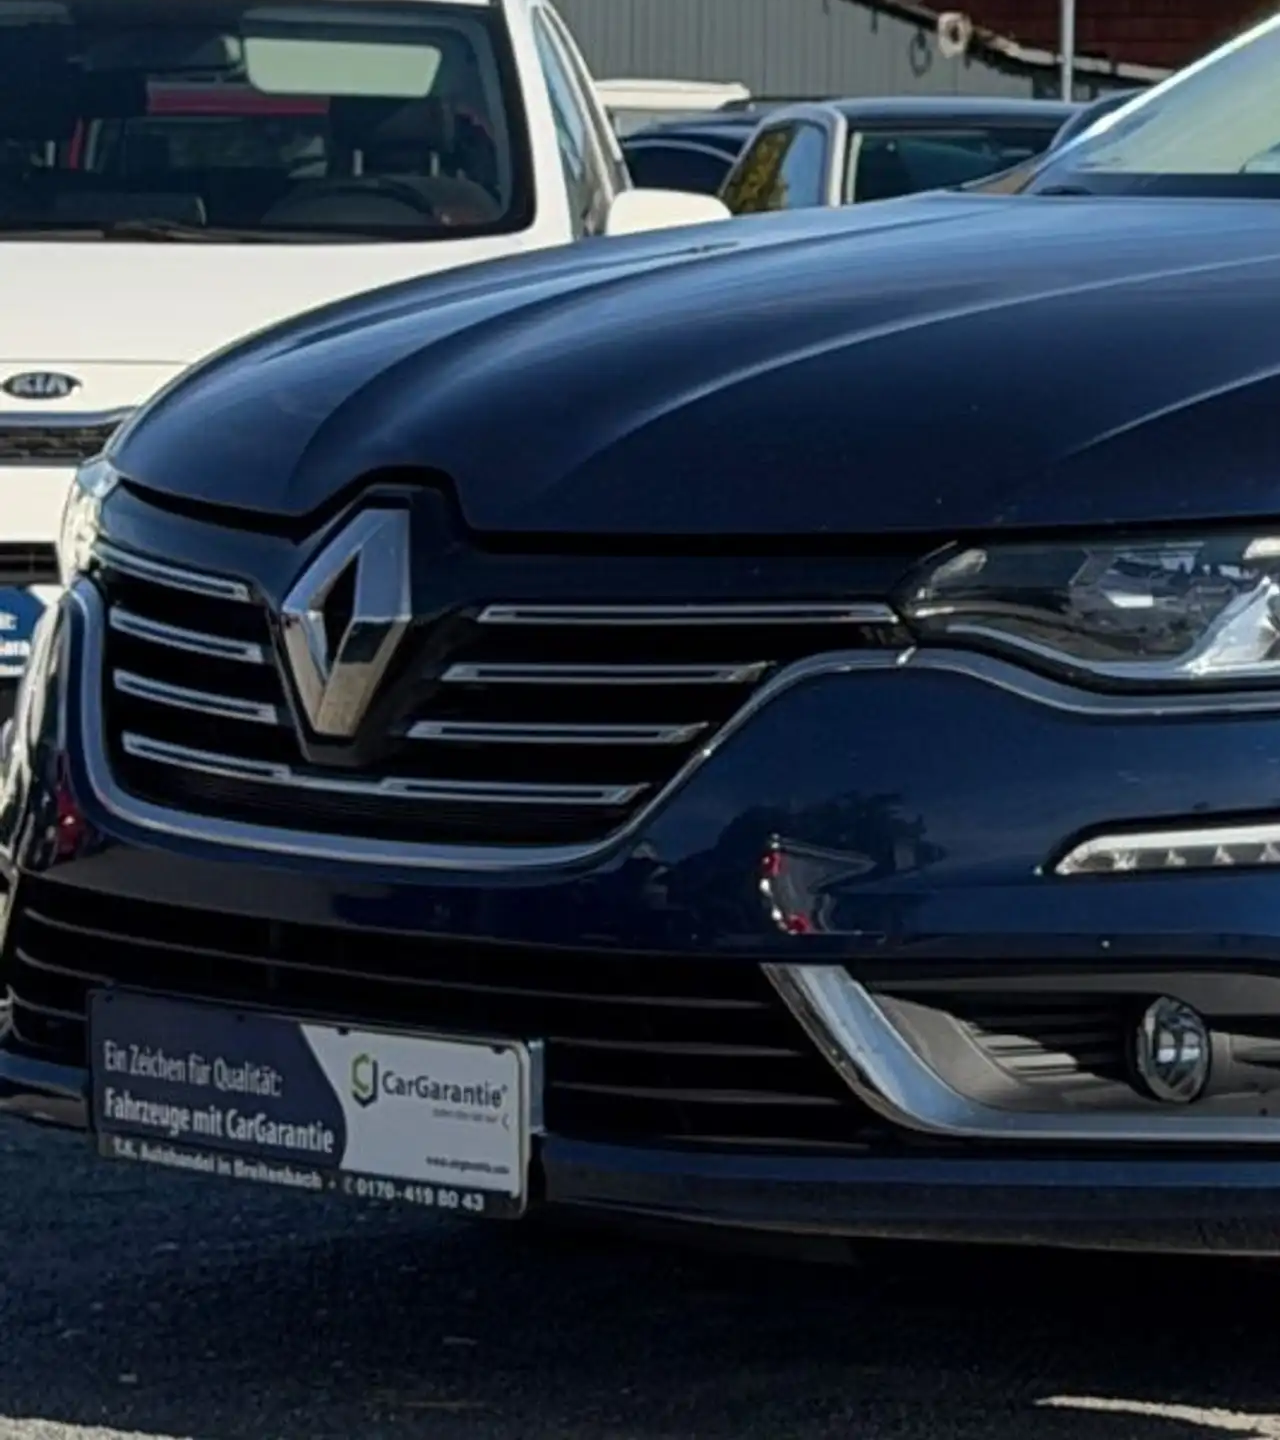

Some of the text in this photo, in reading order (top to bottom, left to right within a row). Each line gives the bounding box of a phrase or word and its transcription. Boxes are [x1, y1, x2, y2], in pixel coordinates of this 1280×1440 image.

[11, 374, 69, 394] KIA
[104, 1039, 283, 1097] Ein Zeichen für Qualität:
[382, 1070, 502, 1109] CarGarantie
[104, 1086, 335, 1155] Fahrzeuge mit CarGarantie
[217, 1155, 232, 1176] in
[461, 1193, 485, 1212] 43
